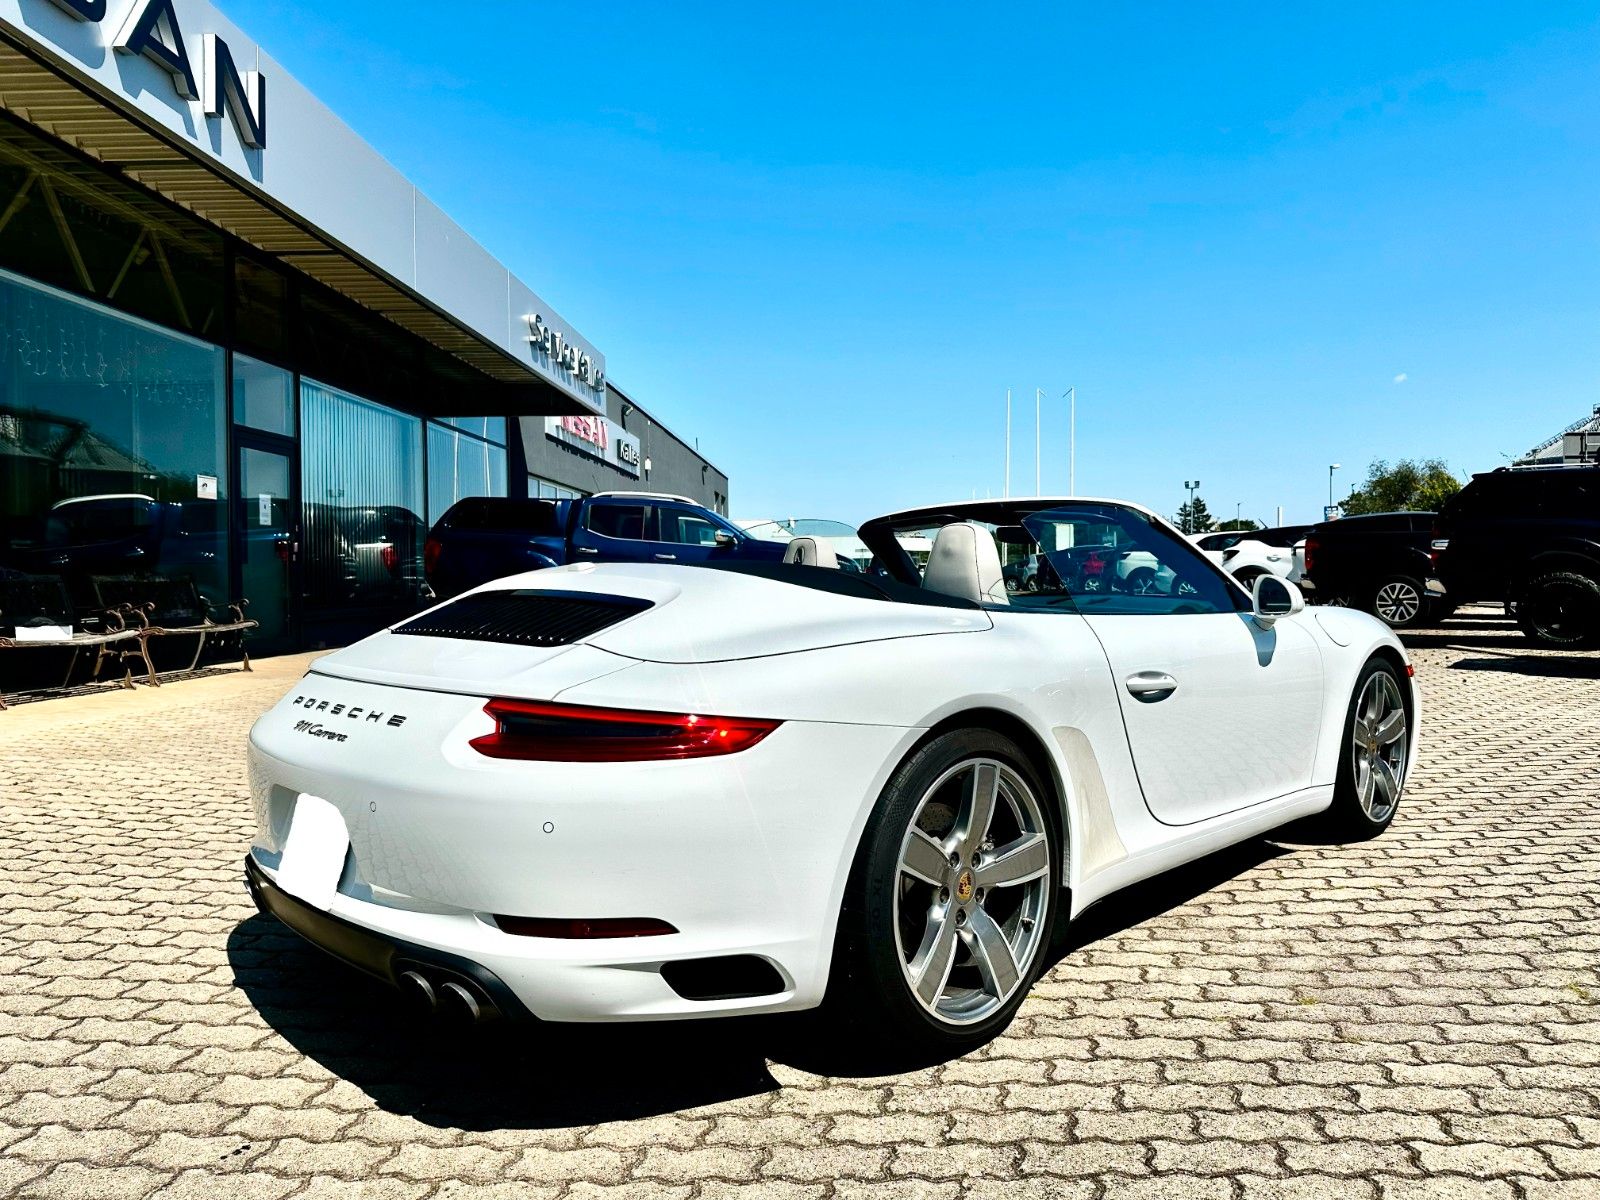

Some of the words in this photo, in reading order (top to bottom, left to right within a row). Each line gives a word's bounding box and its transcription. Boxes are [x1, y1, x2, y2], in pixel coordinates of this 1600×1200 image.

[49, 0, 266, 149] AN
[293, 695, 408, 728] PORSCHE
[308, 723, 349, 743] Carrera
